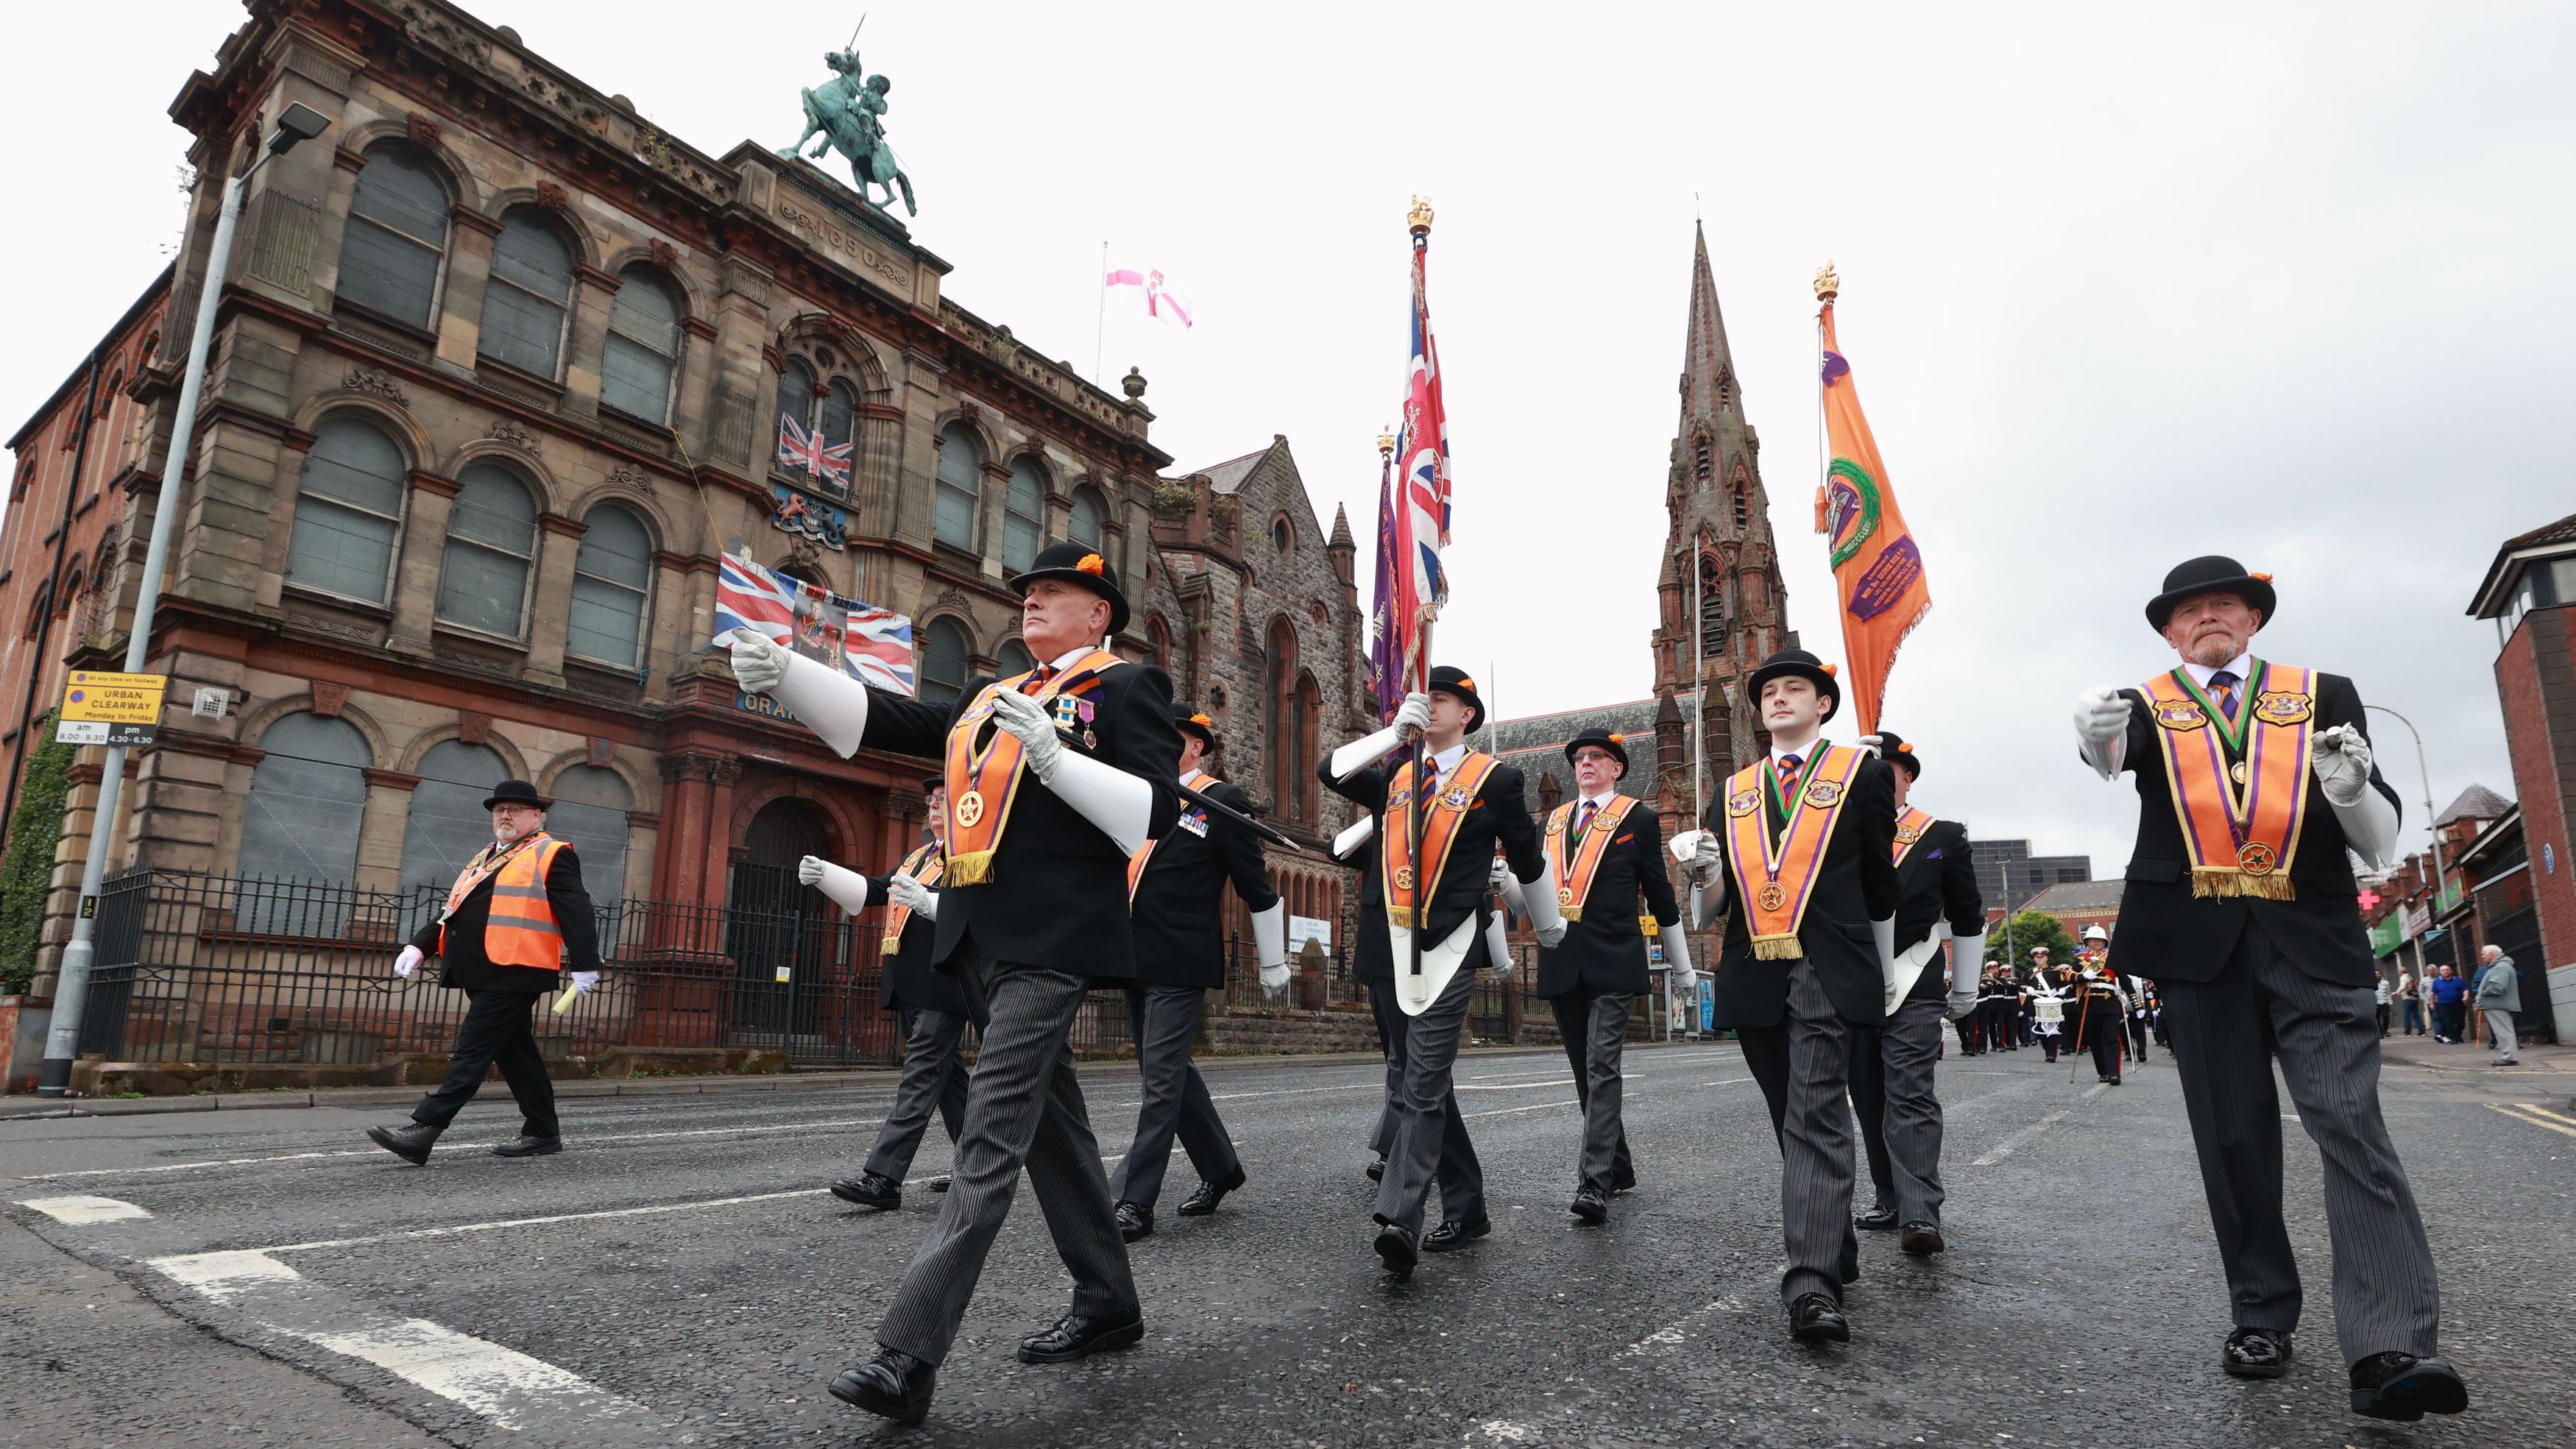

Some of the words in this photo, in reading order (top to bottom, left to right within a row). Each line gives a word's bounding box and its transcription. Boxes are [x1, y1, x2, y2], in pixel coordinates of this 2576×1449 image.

[817, 218, 876, 268] 1690
[91, 701, 151, 710] CLEARWAY
[85, 712, 115, 720] Monday
